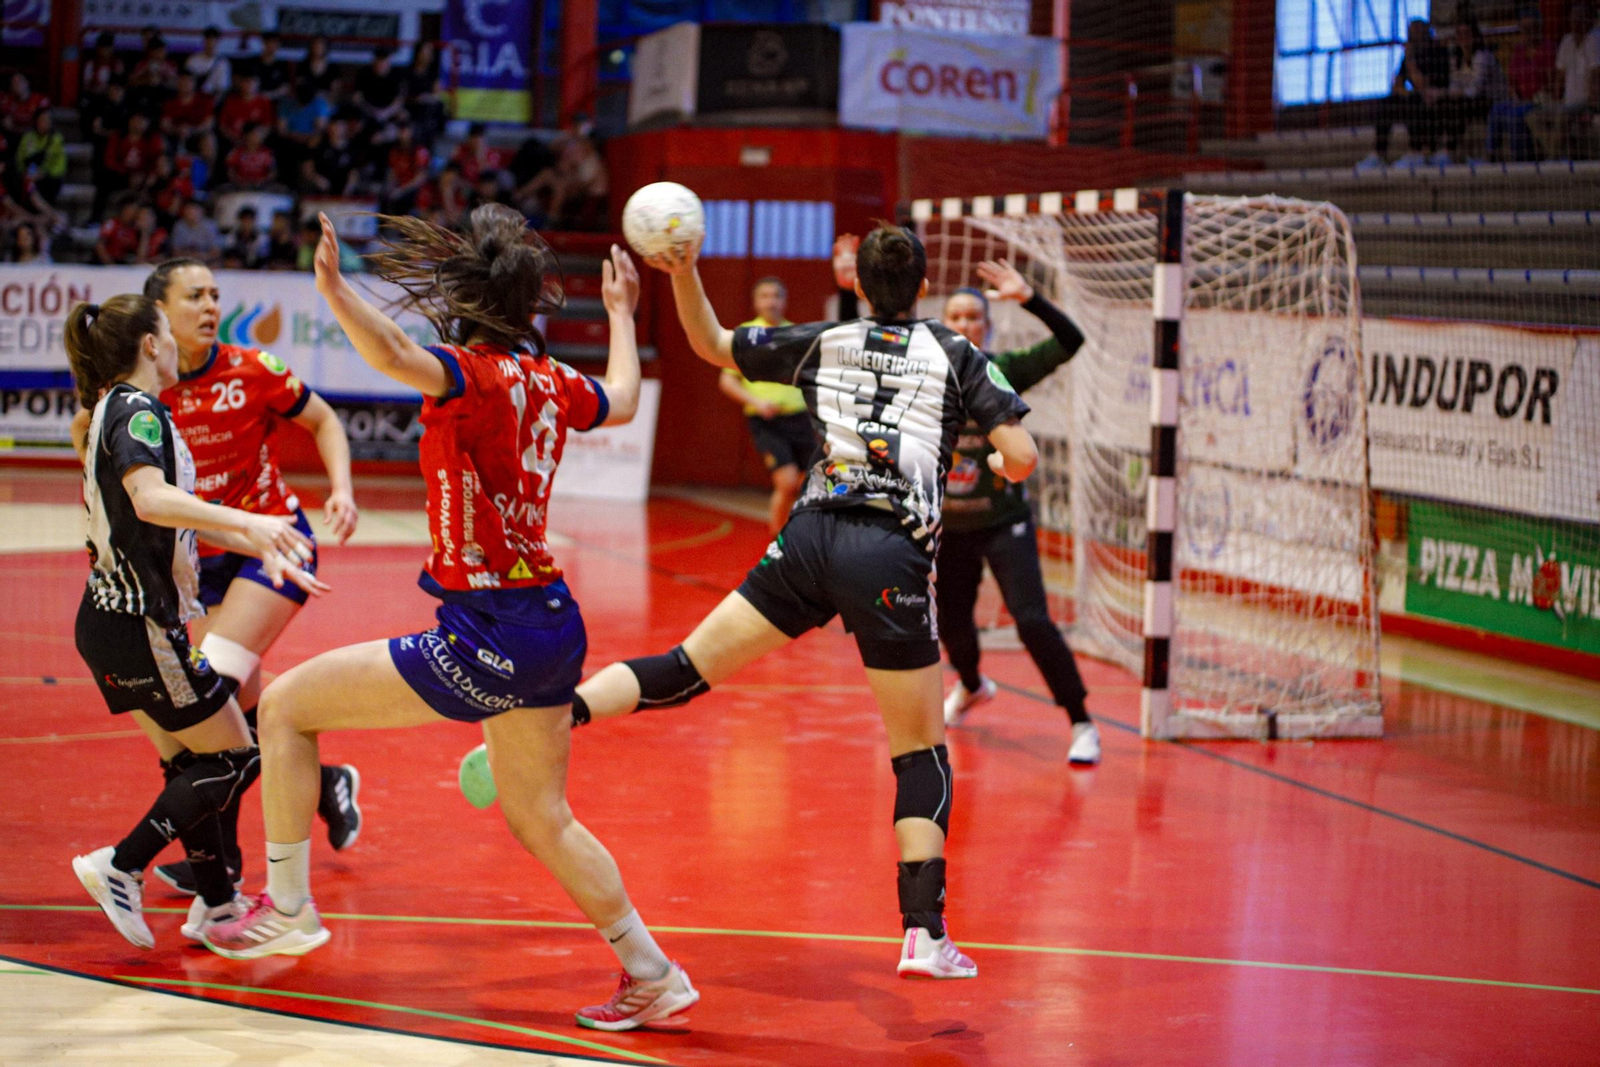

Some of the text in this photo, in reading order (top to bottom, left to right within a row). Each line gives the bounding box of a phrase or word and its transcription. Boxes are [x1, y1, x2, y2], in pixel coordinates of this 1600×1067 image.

[210, 379, 246, 413] 26
[836, 368, 924, 424] 27
[1368, 352, 1560, 427] INDUPOR
[1419, 536, 1500, 600] PIZZA
[477, 648, 514, 675] GIA
